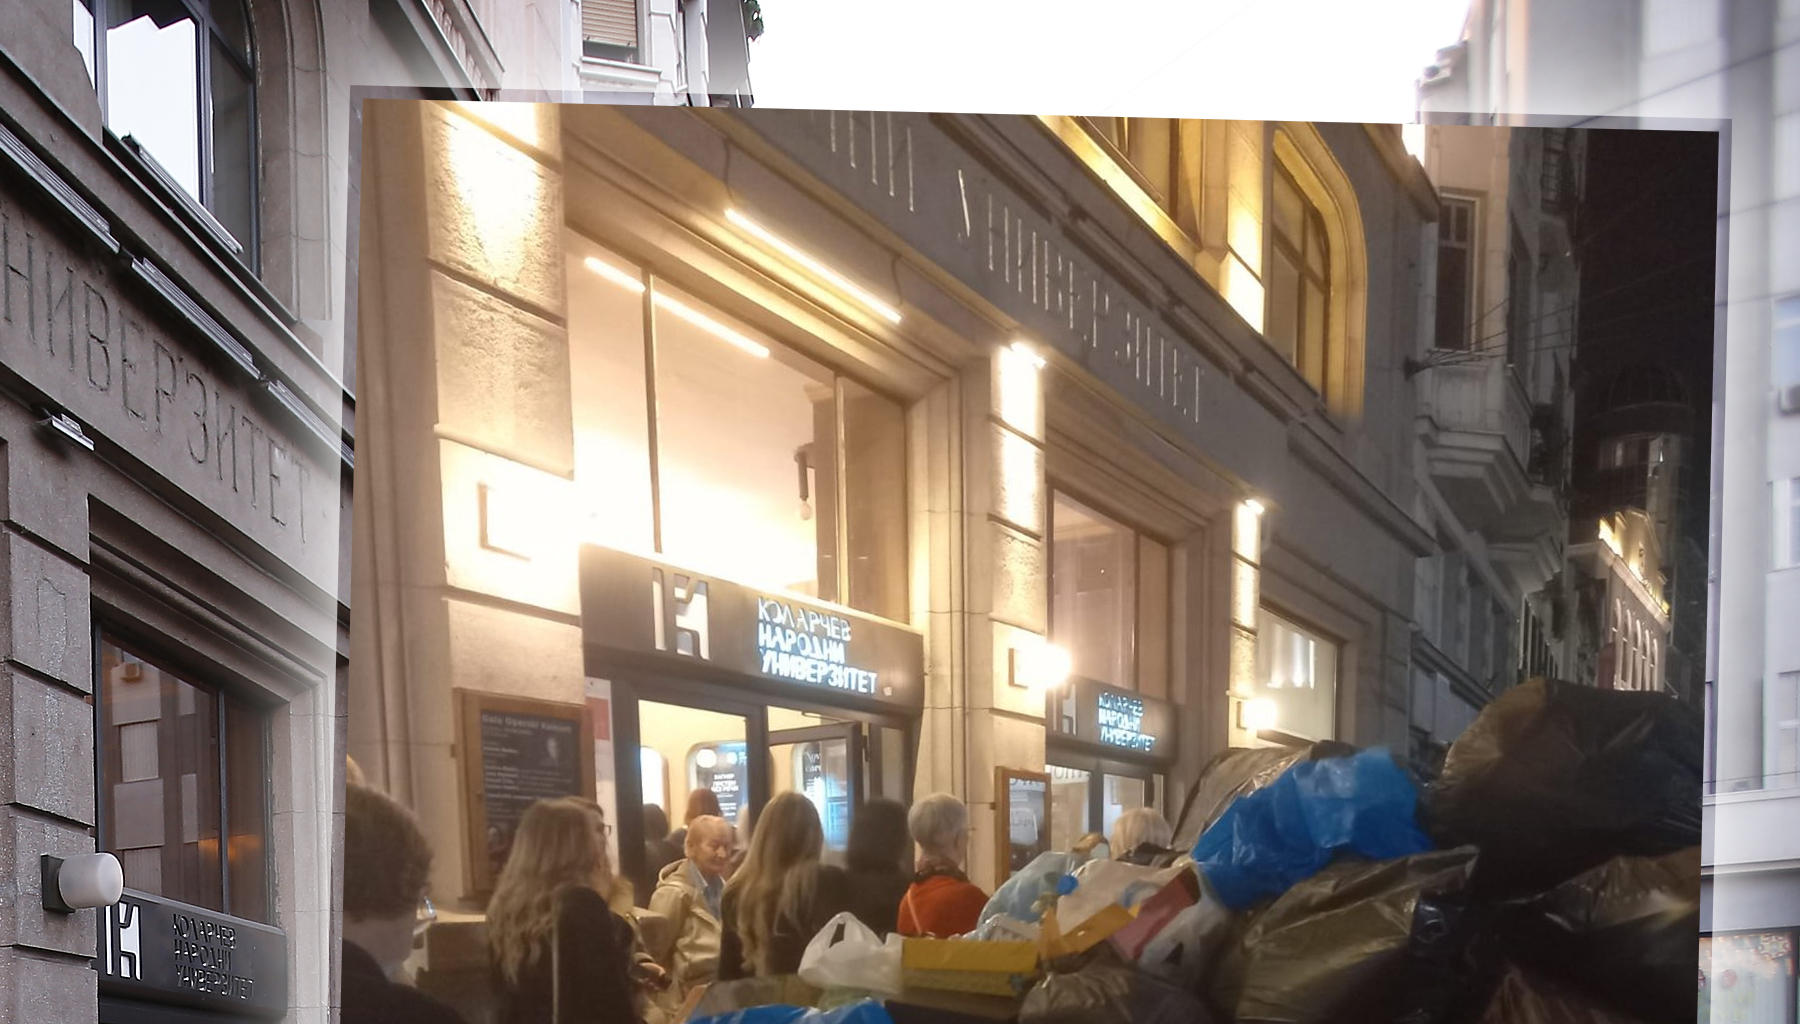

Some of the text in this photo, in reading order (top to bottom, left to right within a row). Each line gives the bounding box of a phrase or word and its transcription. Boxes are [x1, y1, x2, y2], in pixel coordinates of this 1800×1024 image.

[757, 596, 852, 641] КОЛАРЧЕВ
[757, 622, 846, 665] НАРОДНИ
[758, 648, 878, 694] УНИВЕРЗИТЕТ
[173, 913, 237, 950] КОЛАРЧЕВ
[174, 939, 232, 971] НАРОДНИ
[175, 964, 255, 999] УНИВЕРЗИТЕТ
